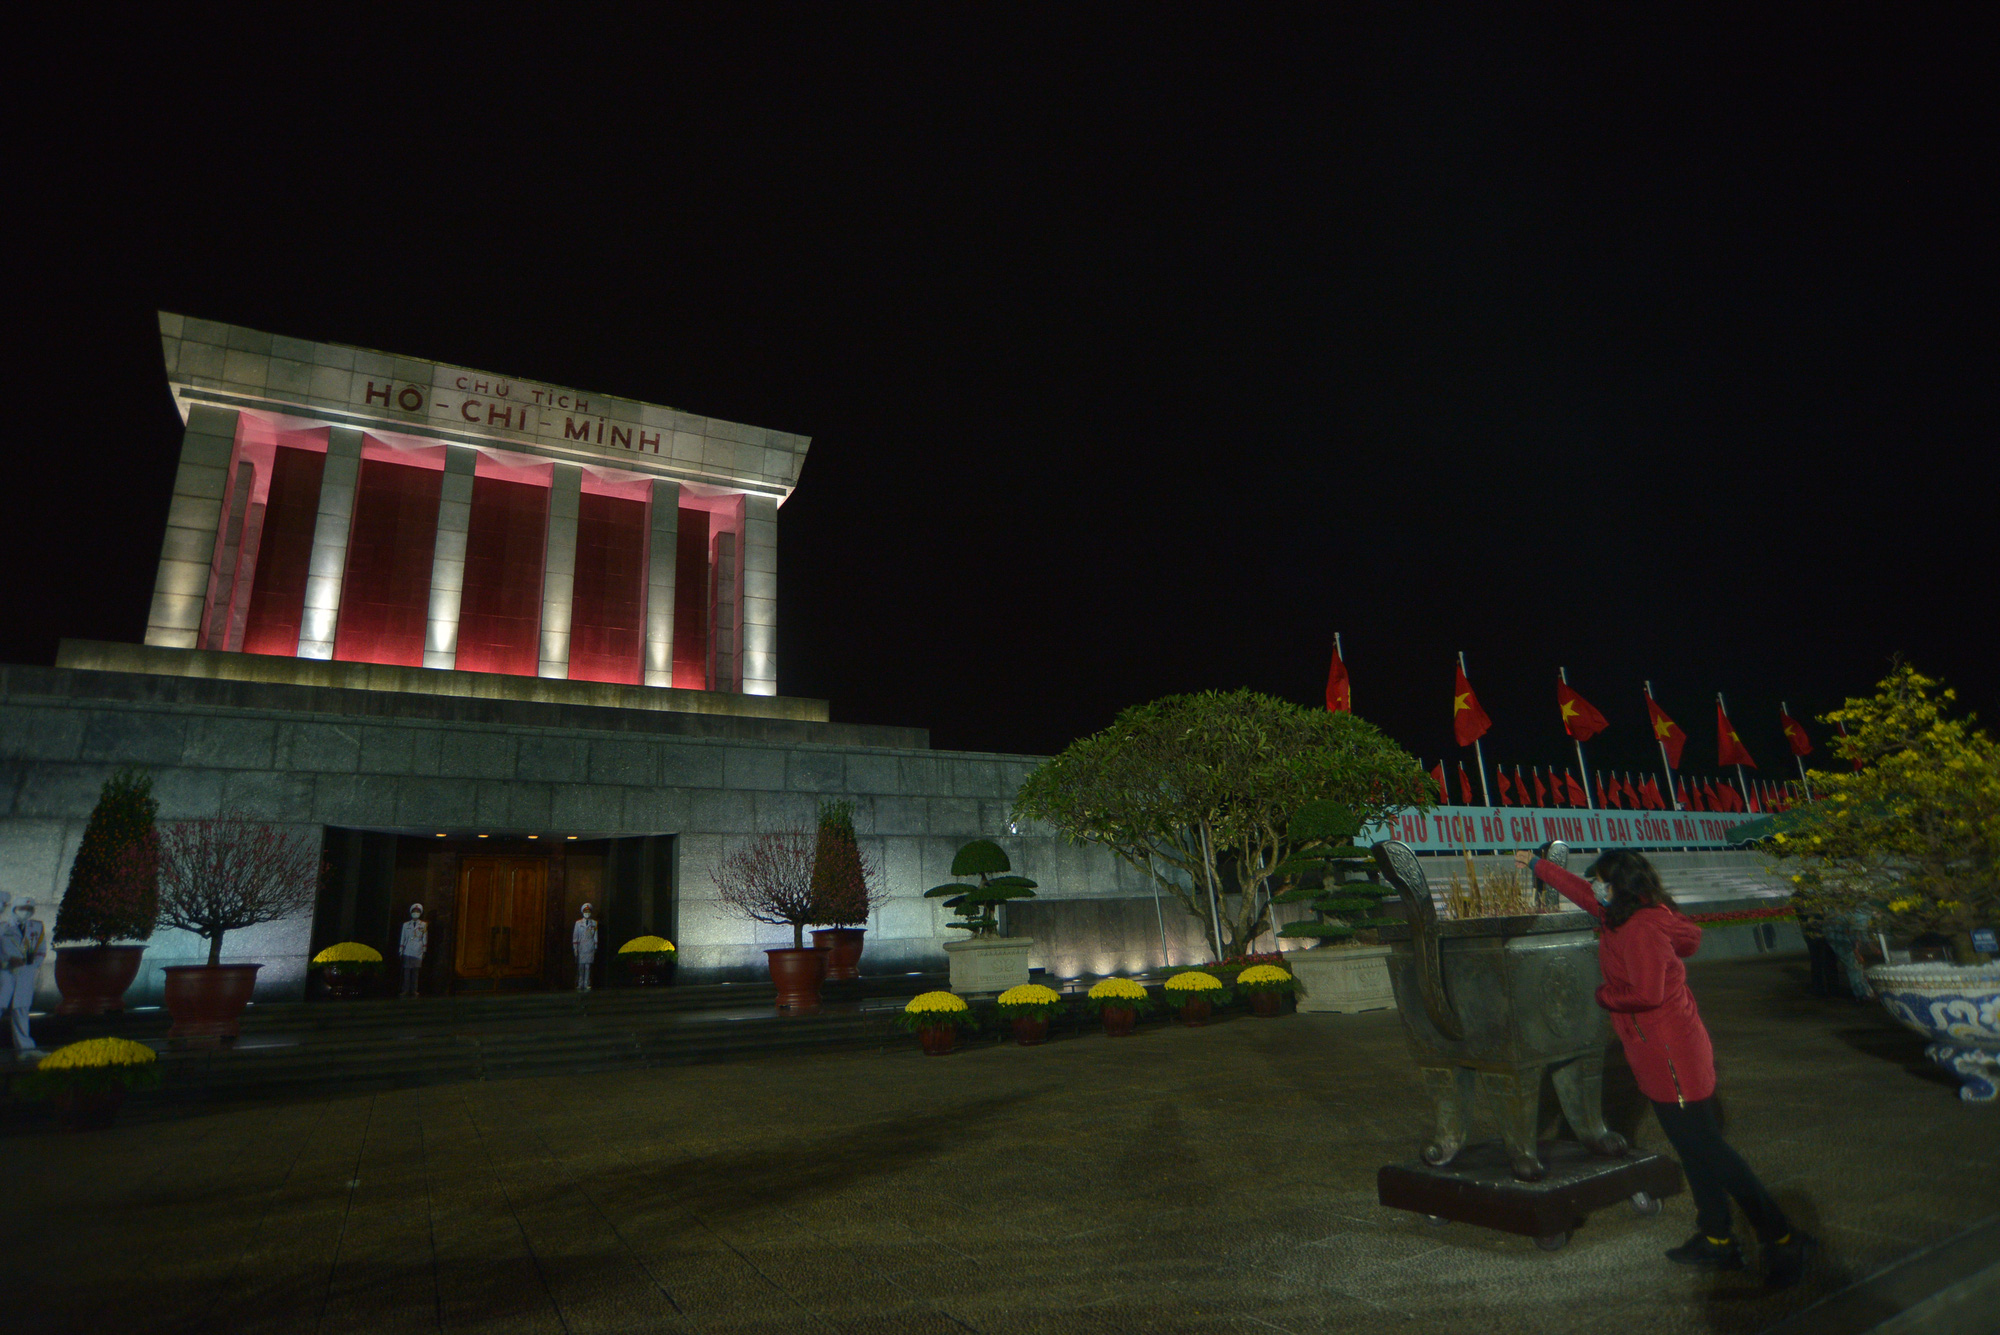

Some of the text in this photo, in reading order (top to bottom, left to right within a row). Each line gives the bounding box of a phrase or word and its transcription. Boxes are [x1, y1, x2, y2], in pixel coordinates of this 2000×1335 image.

[365, 381, 427, 412] HỒ
[461, 400, 532, 431] CHÍ
[456, 377, 588, 412] CHỦ TỊCH
[1433, 815, 1476, 848] TỊCH
[1481, 808, 1505, 842] HỒ
[1510, 811, 1539, 842] CHÍ
[1542, 817, 1585, 842] MINH
[1606, 818, 1632, 846] ĐẠI
[1634, 812, 1671, 841] SỐNG
